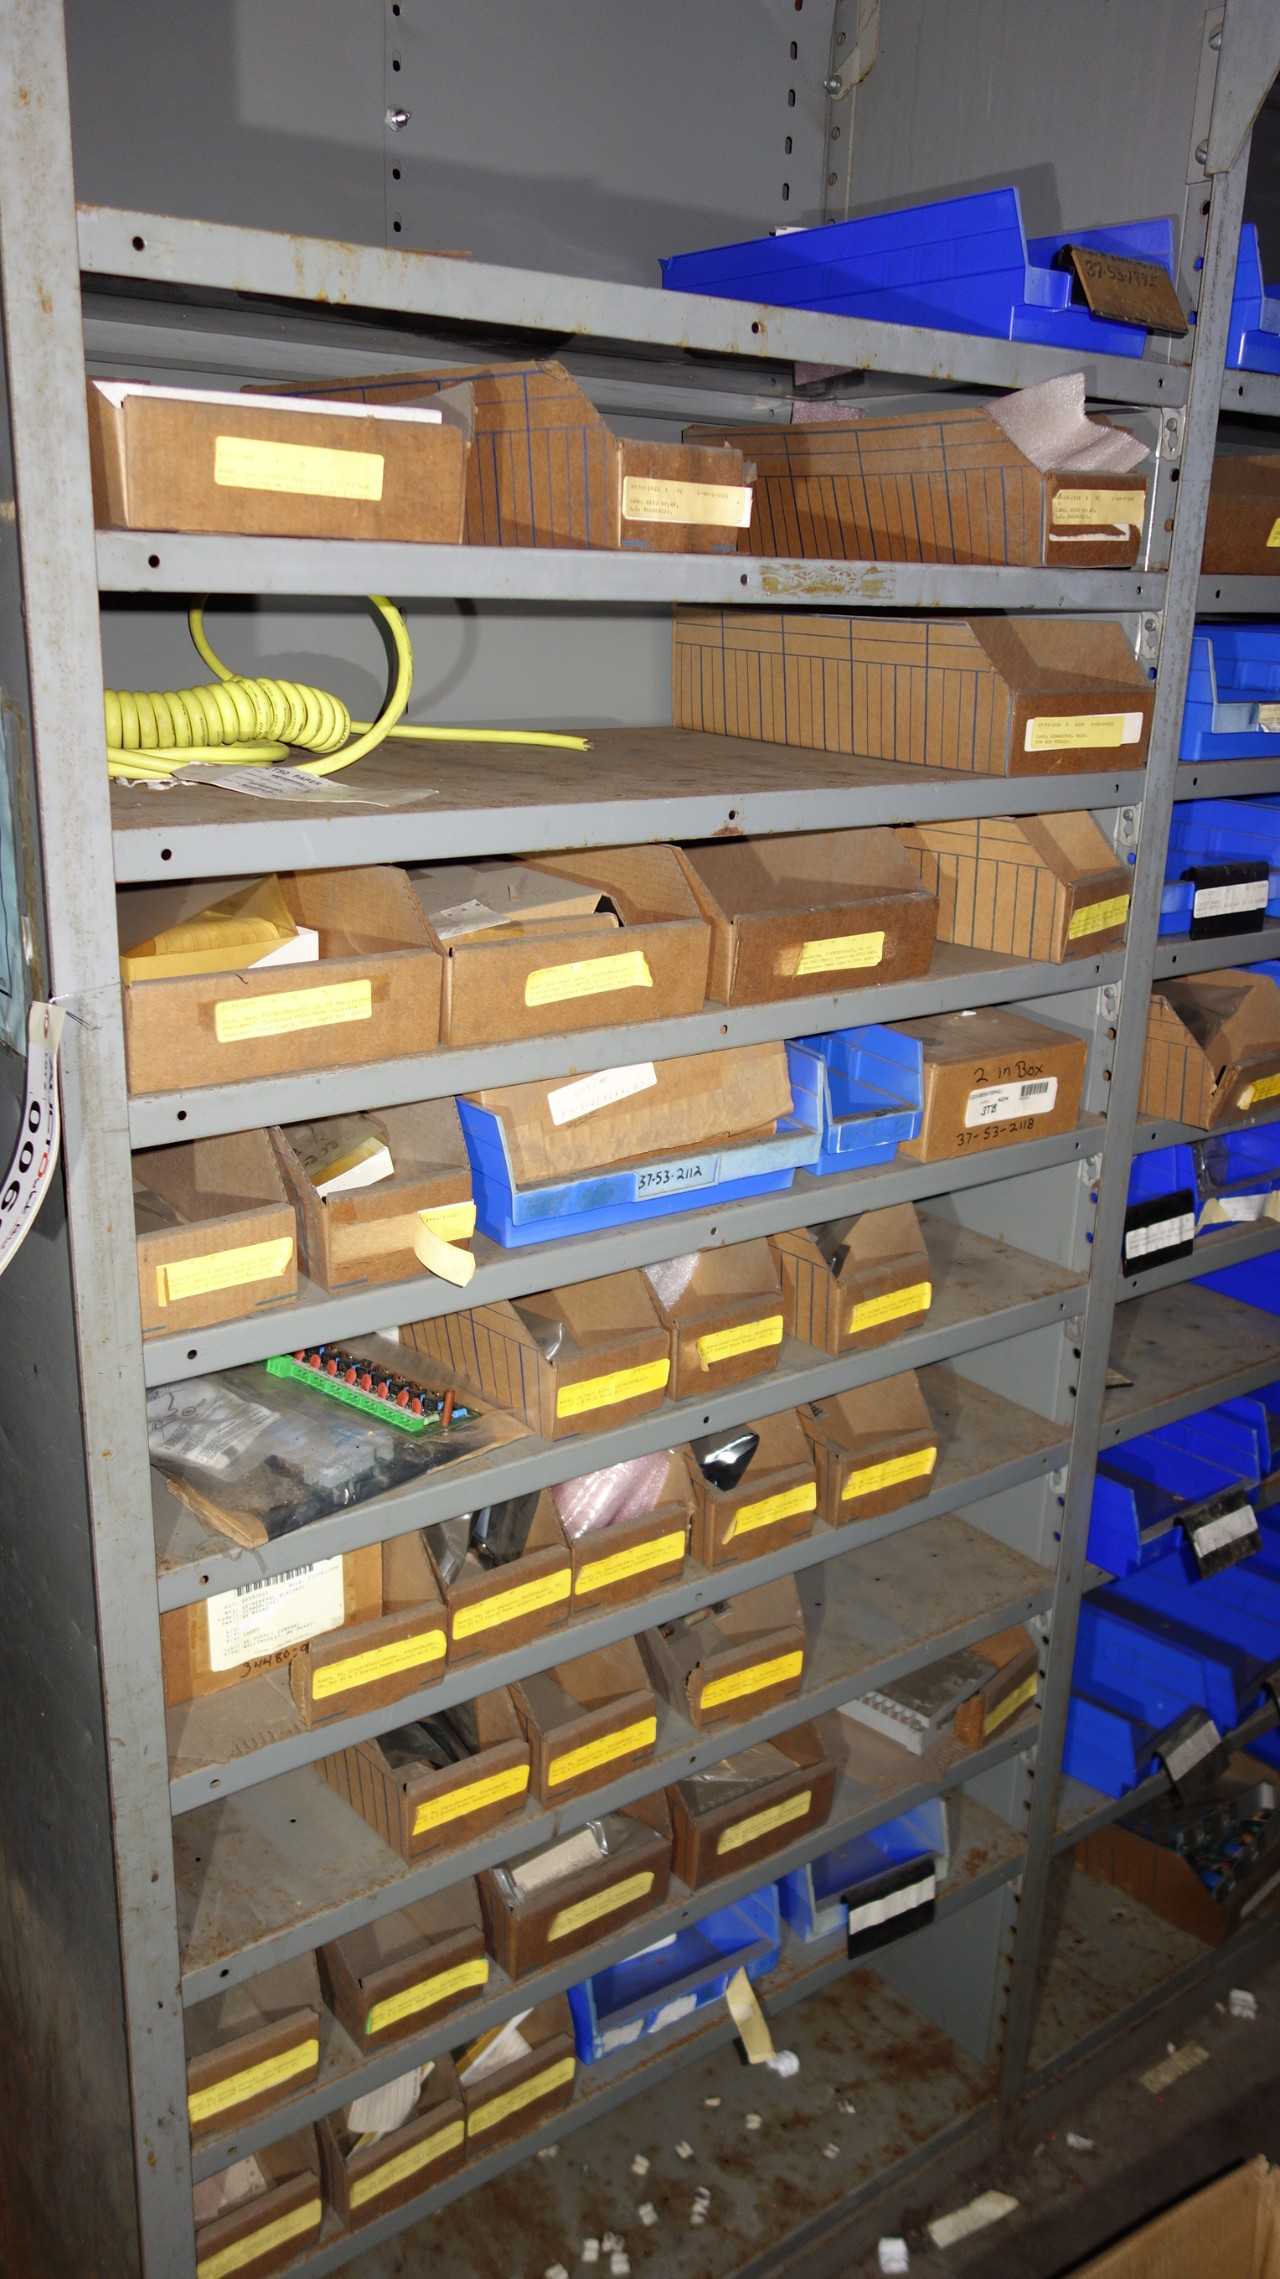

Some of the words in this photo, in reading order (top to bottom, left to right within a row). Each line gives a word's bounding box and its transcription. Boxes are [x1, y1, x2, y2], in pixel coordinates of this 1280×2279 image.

[974, 1067, 988, 1083] 2
[998, 1066, 1010, 1078] in
[1015, 1060, 1043, 1078] Box
